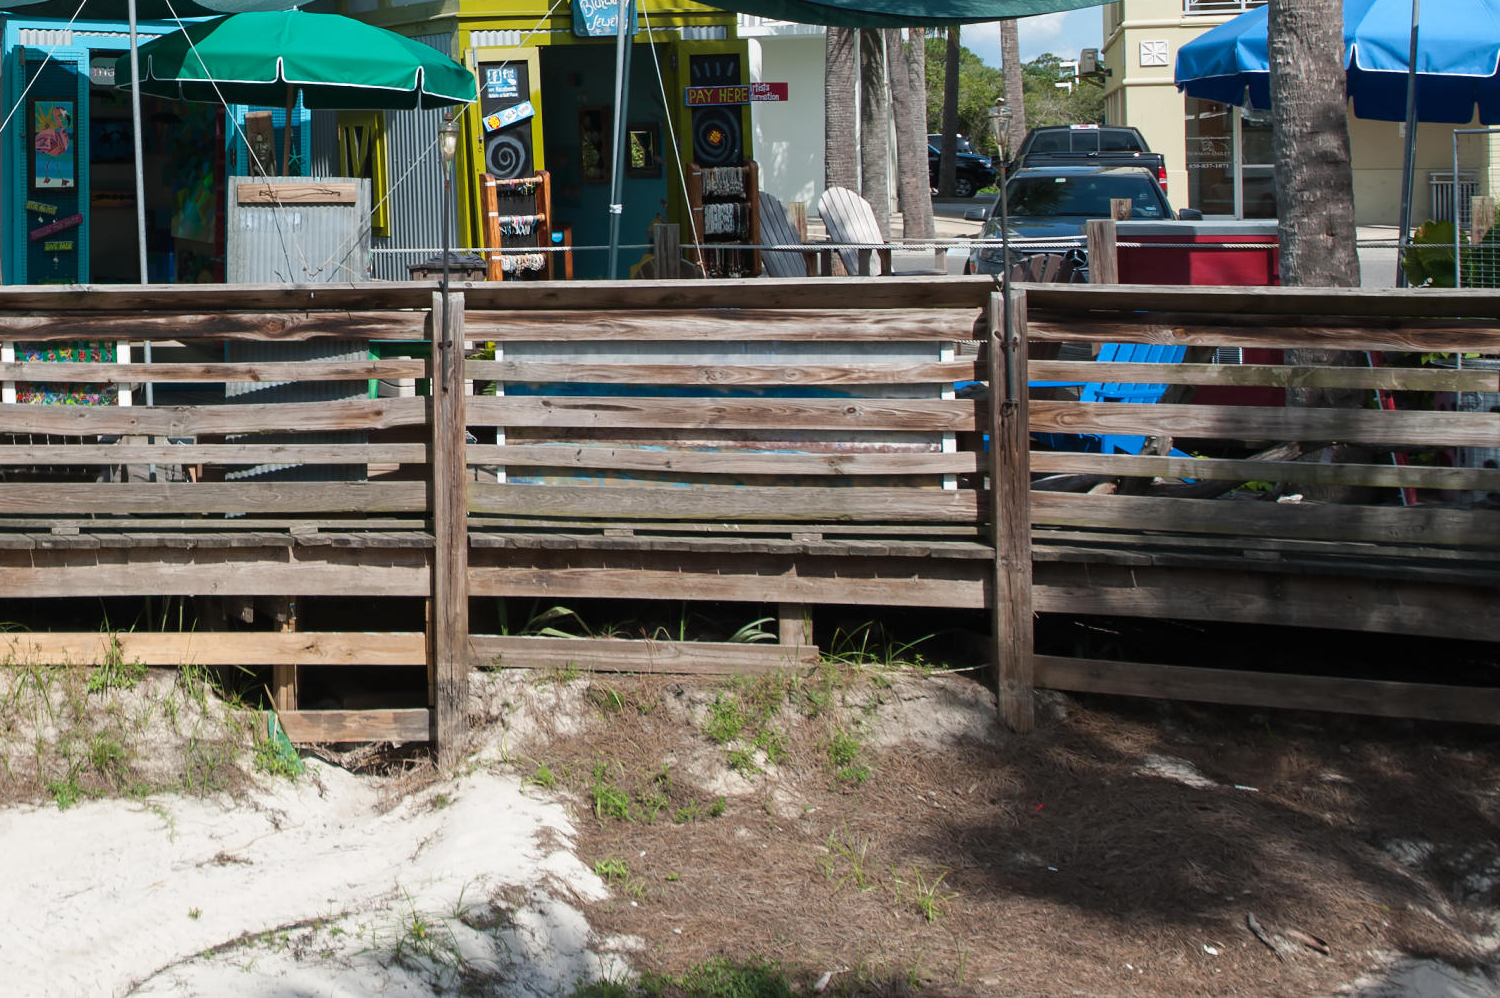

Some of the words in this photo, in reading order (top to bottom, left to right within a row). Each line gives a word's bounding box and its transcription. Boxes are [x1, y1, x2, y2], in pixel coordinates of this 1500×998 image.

[586, 14, 628, 31] Jewel
[689, 89, 714, 104] PAY
[719, 87, 749, 103] HERE
[750, 83, 771, 93] rtists
